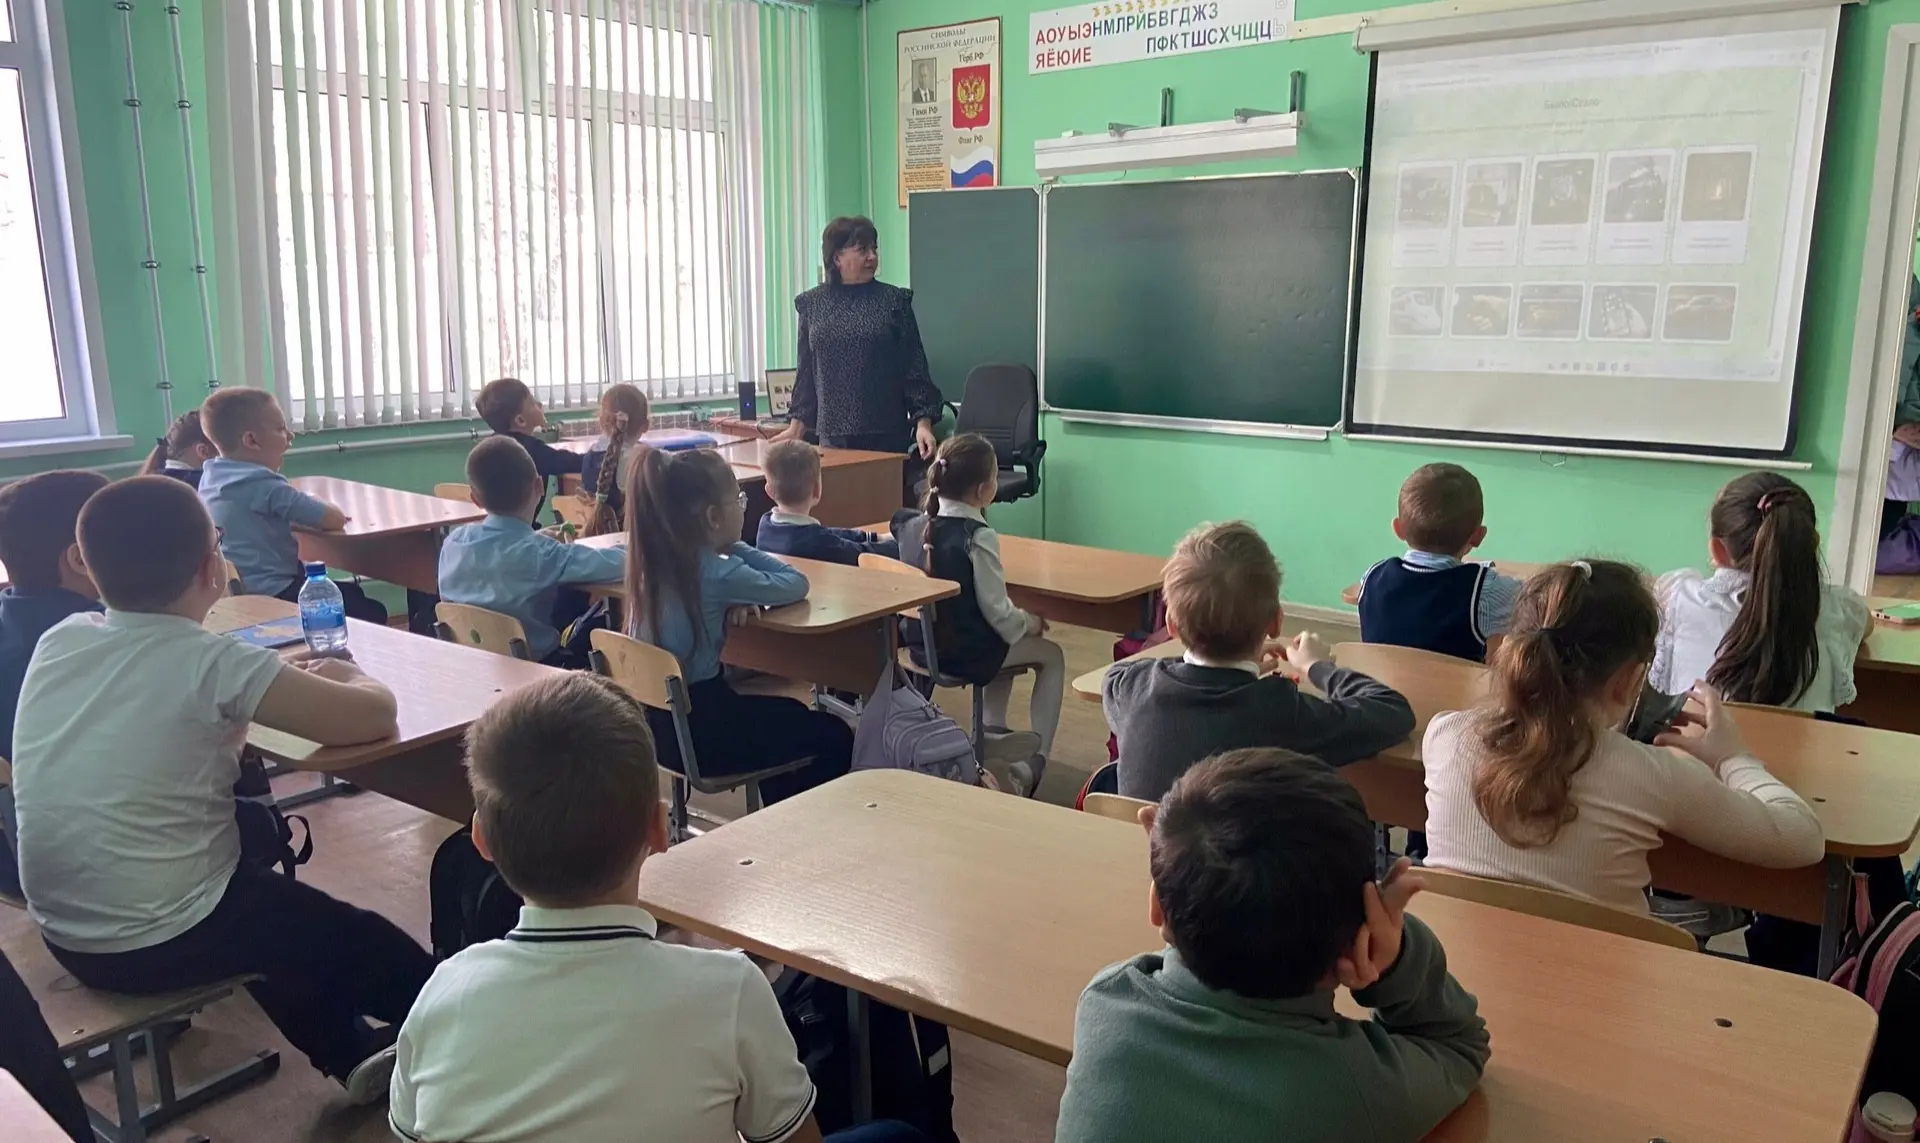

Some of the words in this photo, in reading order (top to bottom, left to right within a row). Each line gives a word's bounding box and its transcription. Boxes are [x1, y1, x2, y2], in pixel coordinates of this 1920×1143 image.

[930, 28, 966, 40] СИМВОЛЫ
[959, 53, 973, 63] Герб
[974, 51, 984, 61] РФ
[1035, 46, 1092, 69] ЯЁЮИЕ
[928, 105, 938, 115] РФ
[973, 134, 983, 144] РФ
